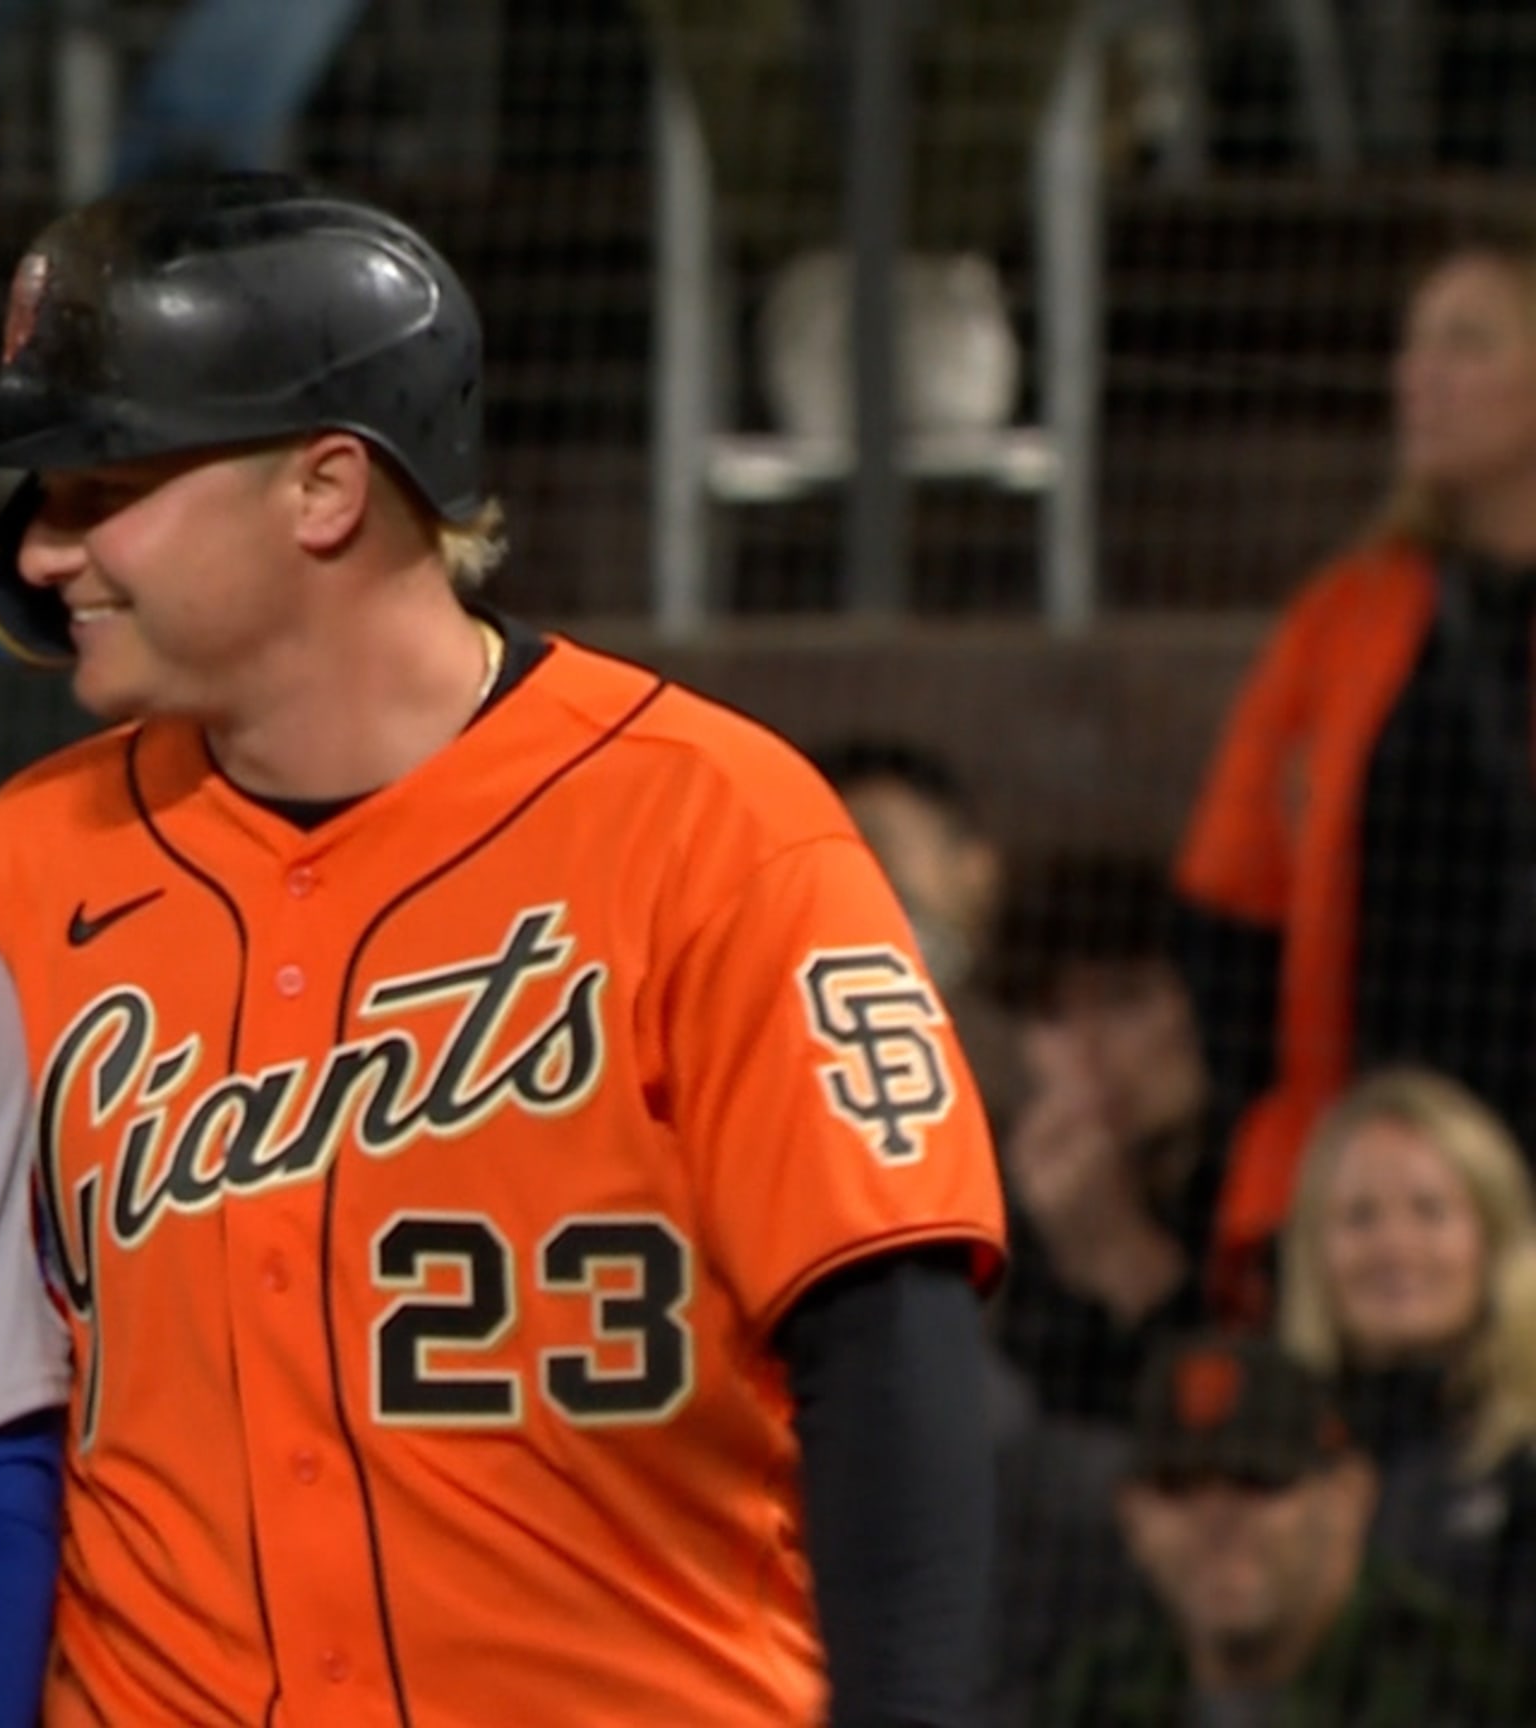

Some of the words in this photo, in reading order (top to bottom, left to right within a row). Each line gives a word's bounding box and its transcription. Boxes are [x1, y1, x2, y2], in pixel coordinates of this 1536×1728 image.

[796, 944, 955, 1167] SF
[39, 900, 606, 1455] Giants
[372, 1211, 693, 1424] 23
